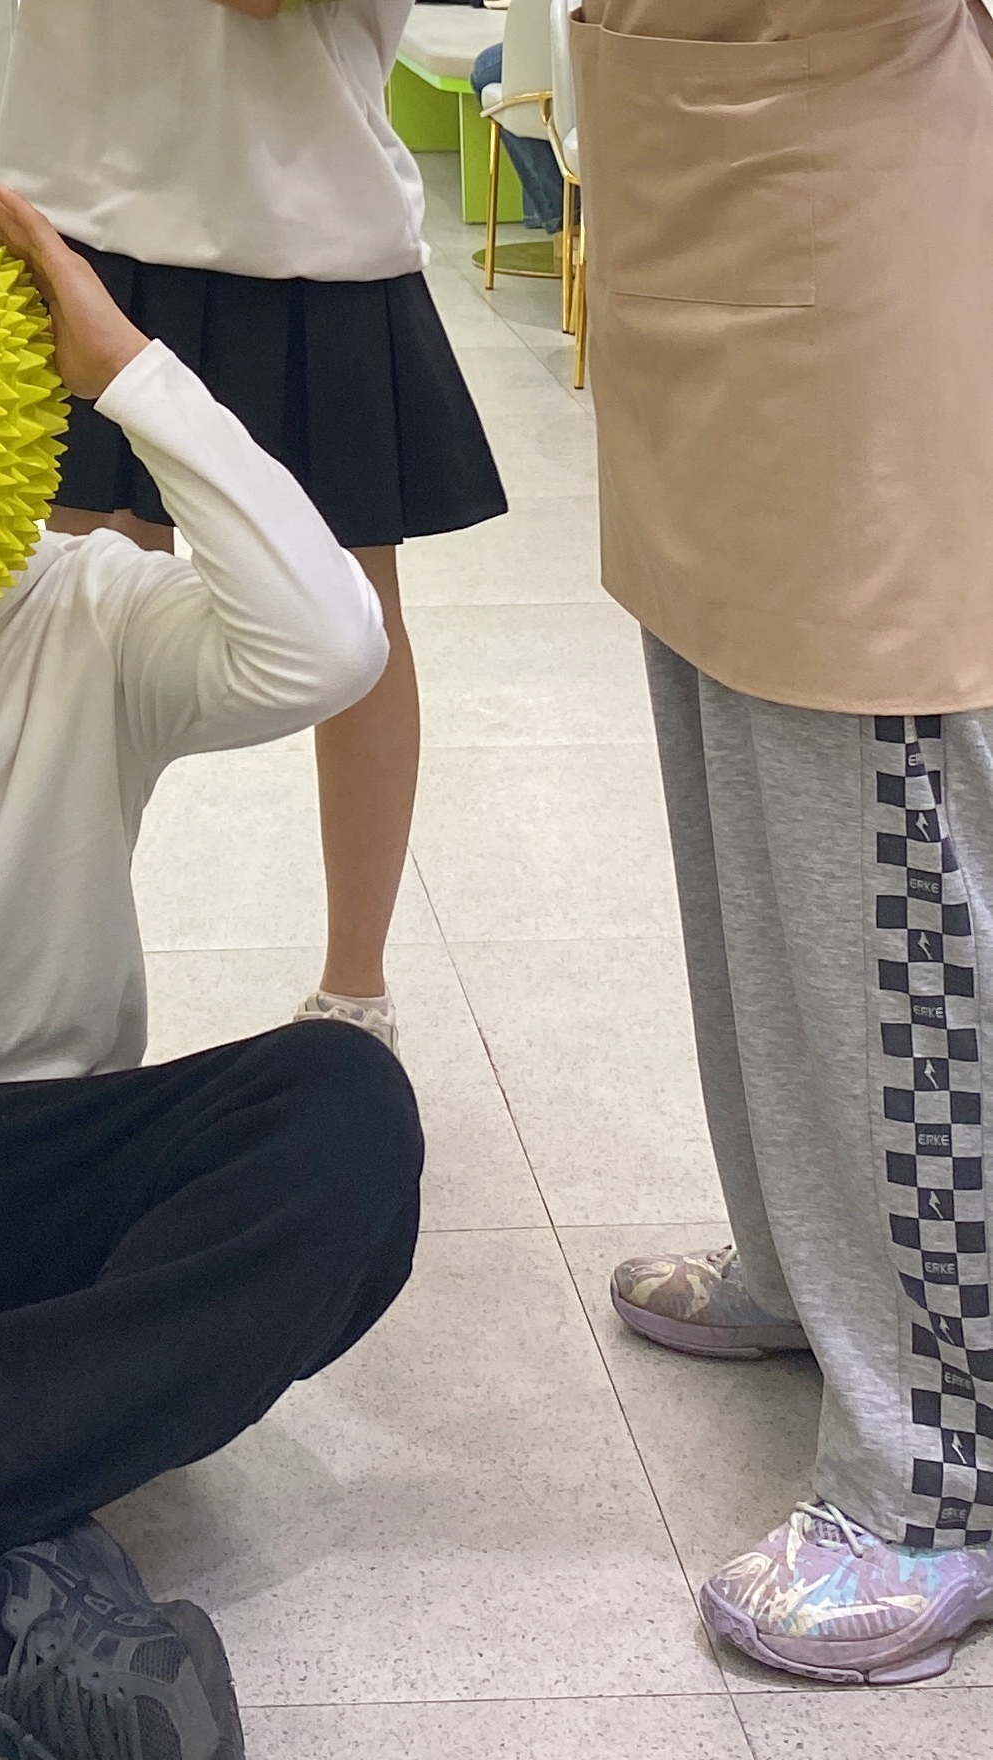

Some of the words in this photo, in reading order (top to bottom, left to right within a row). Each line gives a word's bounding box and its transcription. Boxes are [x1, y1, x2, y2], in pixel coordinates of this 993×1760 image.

[908, 878, 940, 894] ERKE
[912, 1004, 944, 1019] ERKE
[917, 1133, 950, 1147] ERKE
[924, 1261, 956, 1275] ERKE
